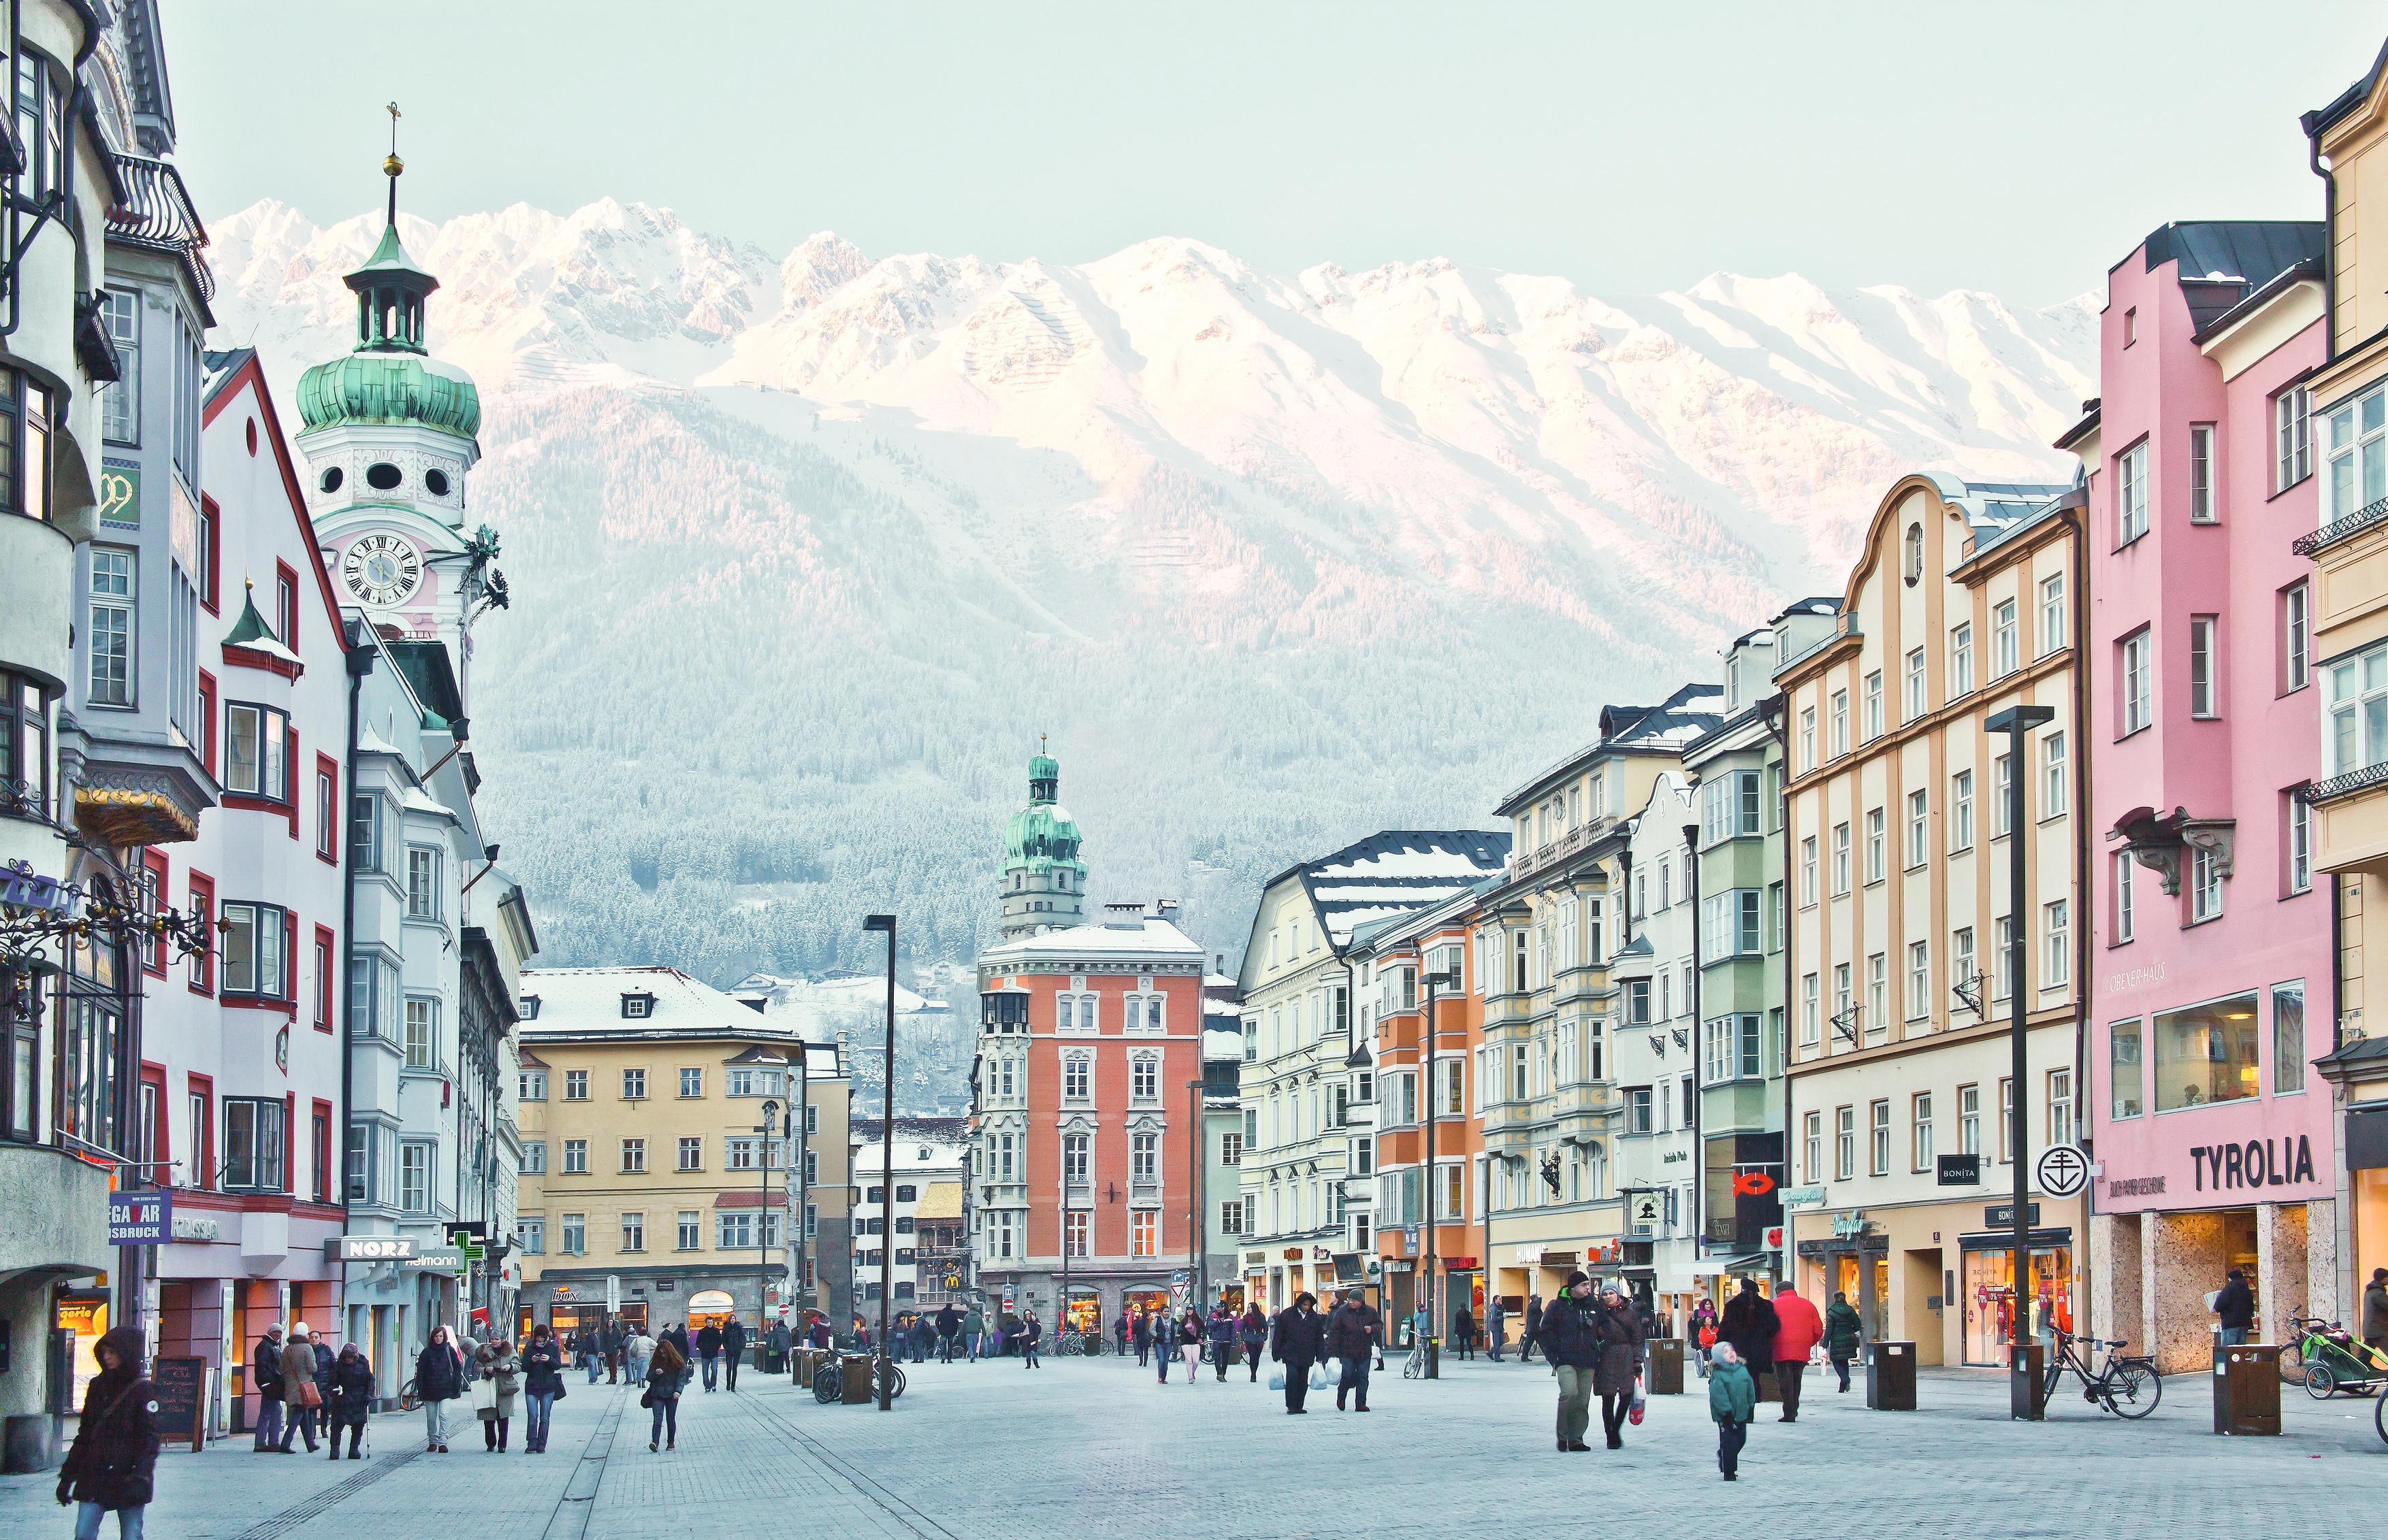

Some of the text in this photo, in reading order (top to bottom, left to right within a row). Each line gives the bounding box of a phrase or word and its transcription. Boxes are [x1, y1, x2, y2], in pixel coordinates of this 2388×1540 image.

[2110, 962, 2166, 992] OBEXER-HAUS
[1677, 1151, 1687, 1161] Pub
[2190, 1134, 2314, 1191] TYROLIA
[1783, 1188, 1822, 1203] Douglas
[1831, 1209, 1864, 1241] Douglas
[349, 1241, 411, 1258] NORZ
[552, 1288, 579, 1301] box
[1978, 1294, 1988, 1304] 70%
[2038, 1294, 2048, 1303] 70%
